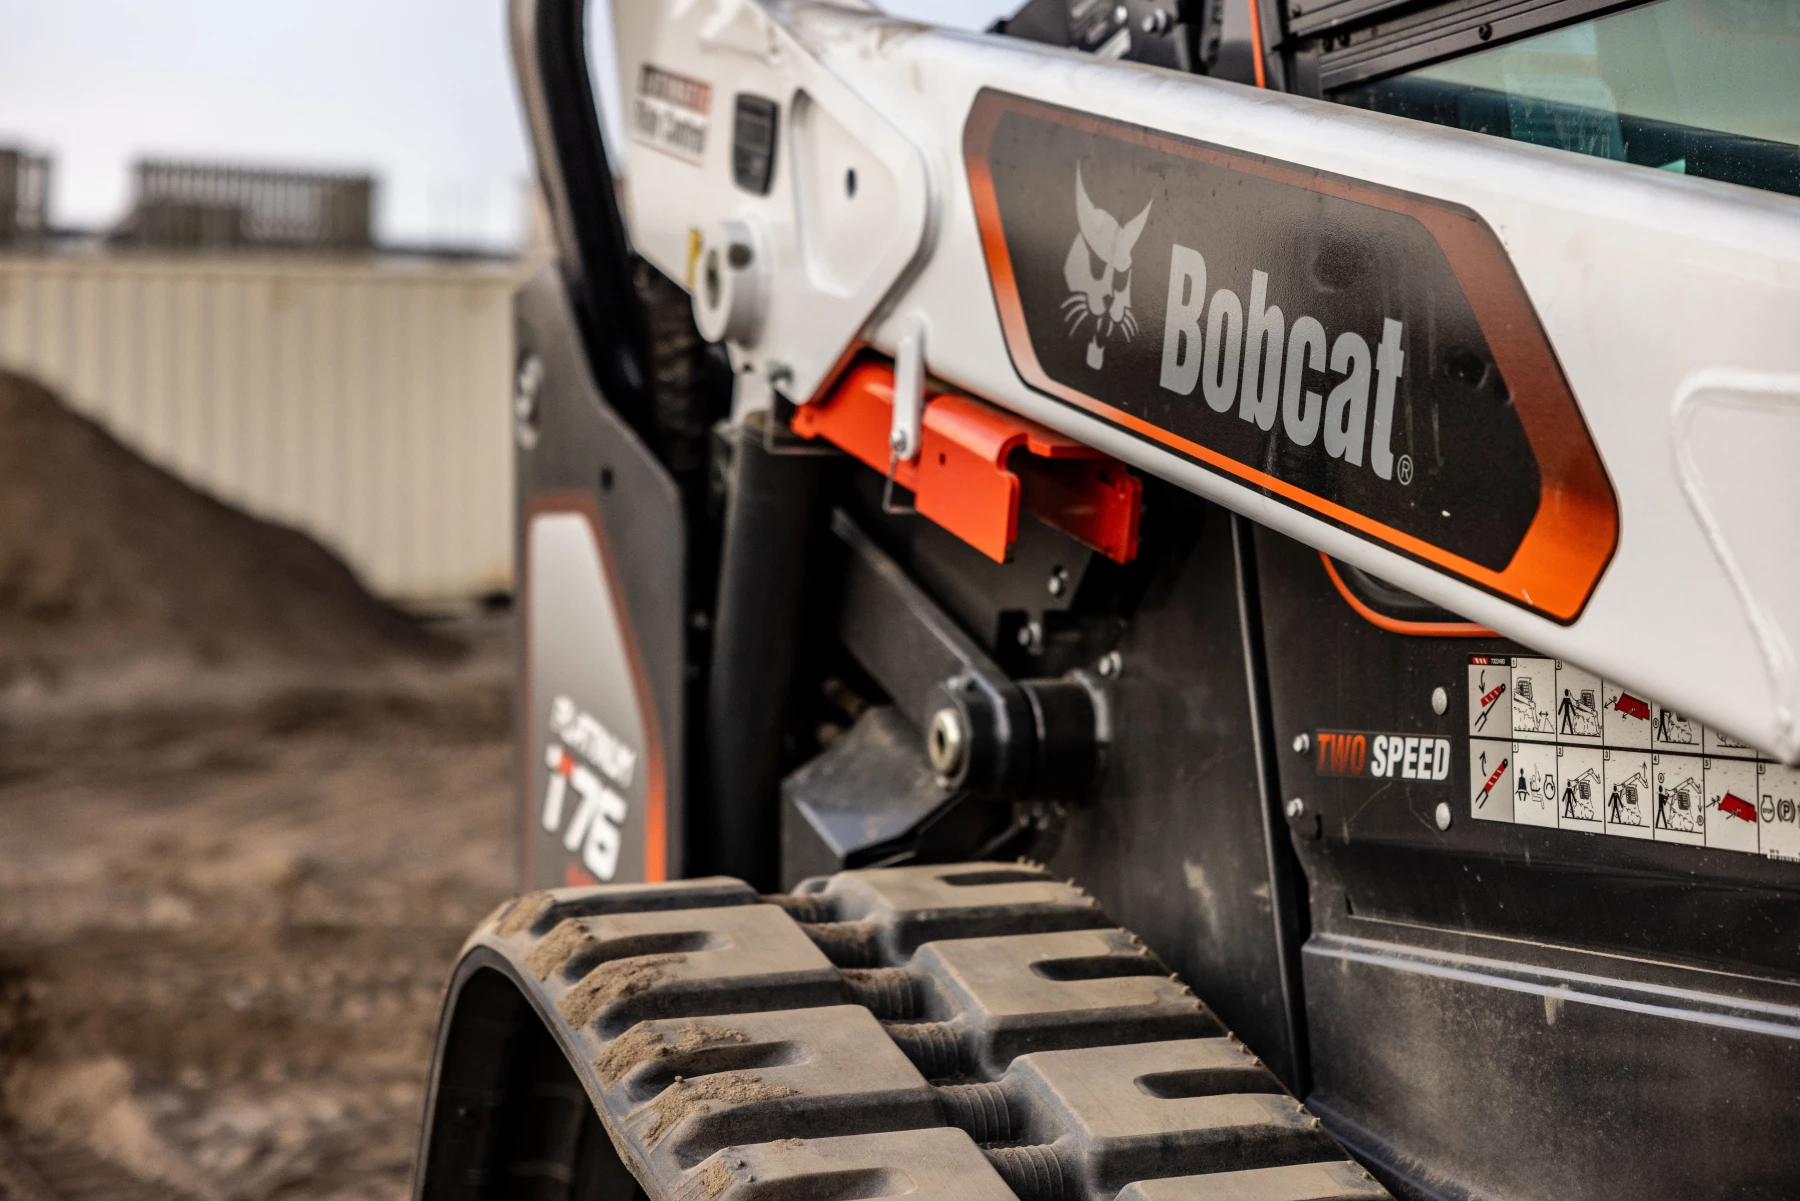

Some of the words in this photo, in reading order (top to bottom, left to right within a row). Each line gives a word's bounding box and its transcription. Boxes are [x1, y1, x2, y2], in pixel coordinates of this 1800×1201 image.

[1317, 733, 1367, 776] TWO
[1371, 734, 1451, 781] SPEED
[1783, 804, 1790, 818] P
